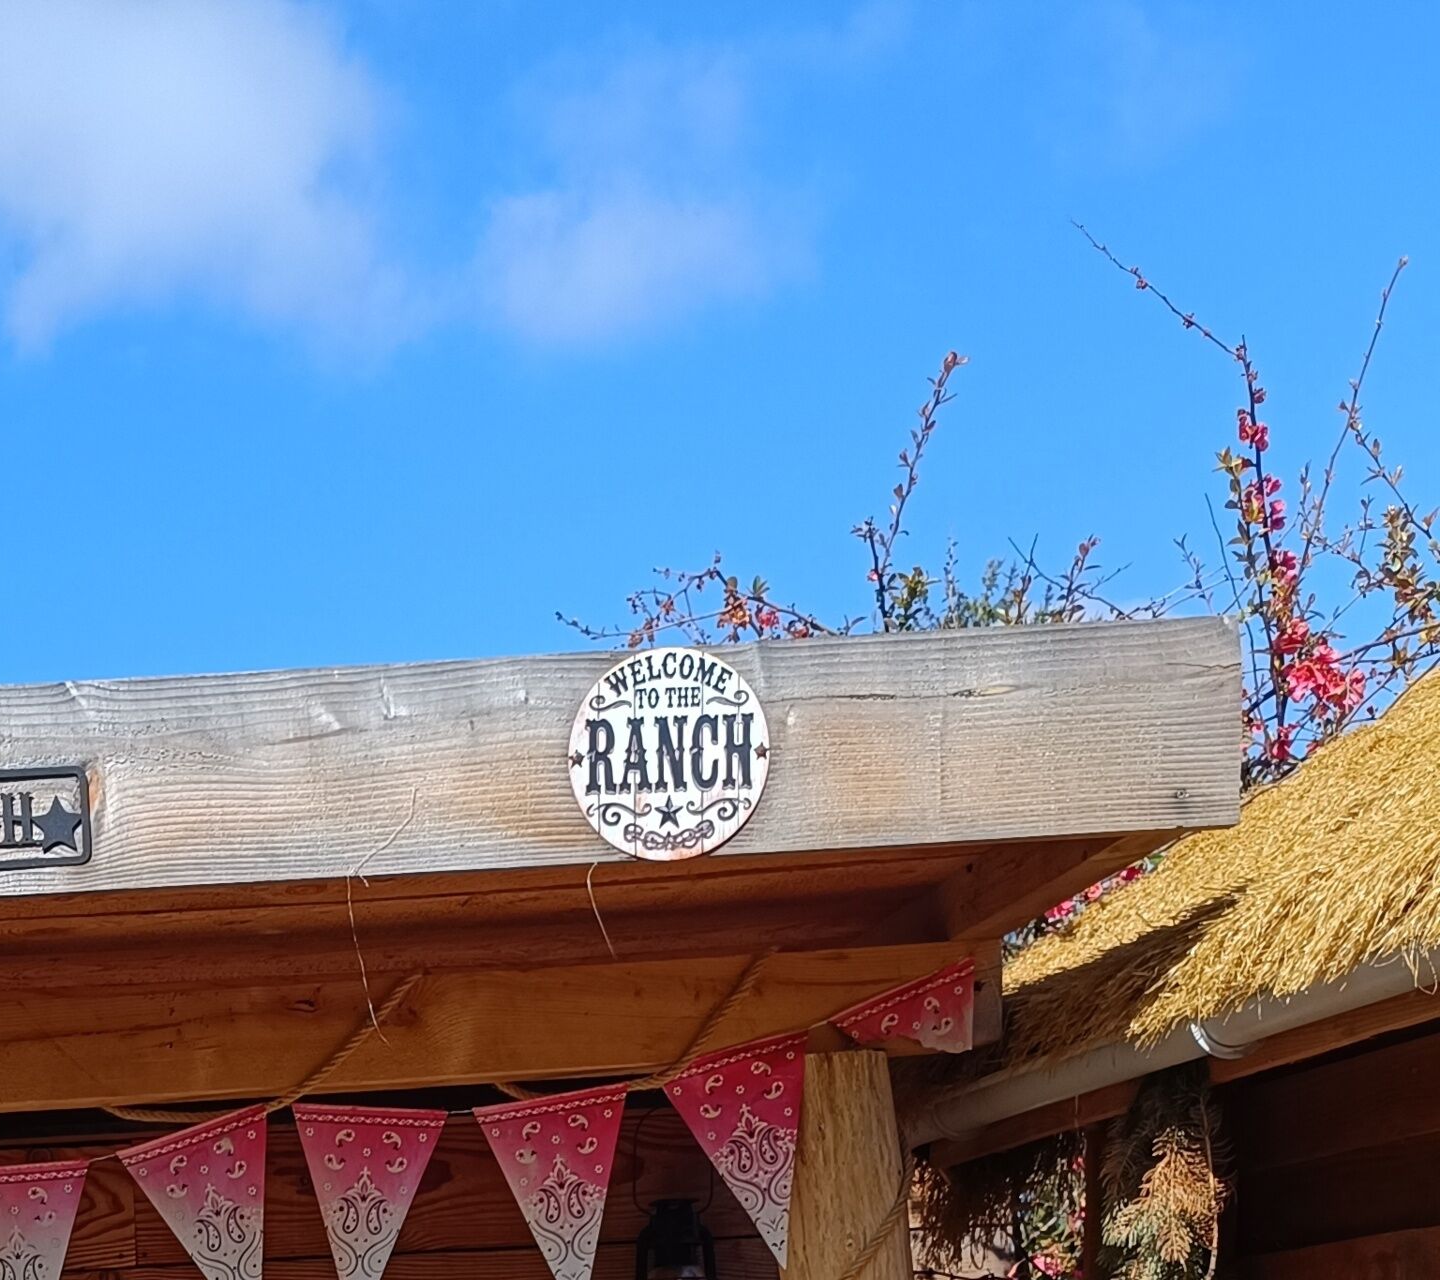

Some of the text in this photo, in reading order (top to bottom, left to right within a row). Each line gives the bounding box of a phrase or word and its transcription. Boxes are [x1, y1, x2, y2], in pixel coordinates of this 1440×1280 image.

[604, 652, 733, 697] WELCOME
[636, 686, 702, 709] TO THE
[585, 712, 754, 796] RANCH
